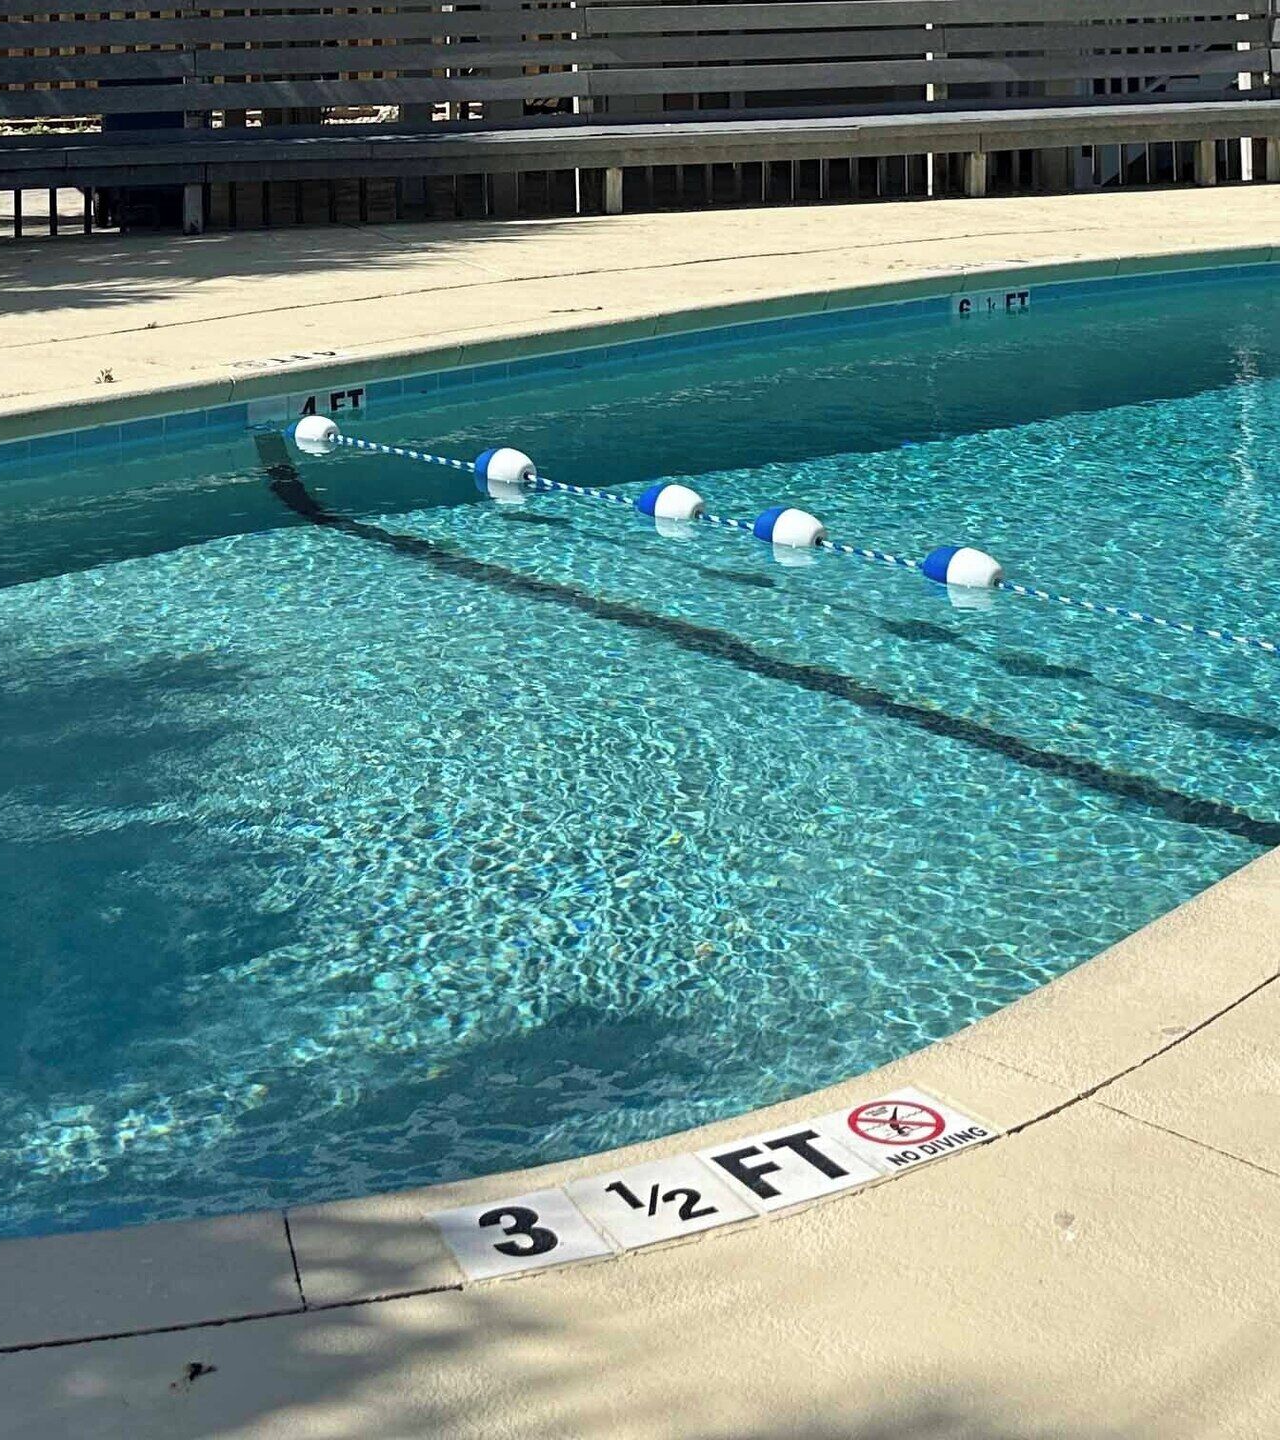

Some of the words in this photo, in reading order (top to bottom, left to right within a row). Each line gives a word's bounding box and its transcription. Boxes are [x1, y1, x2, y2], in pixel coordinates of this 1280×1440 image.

[1006, 291, 1029, 308] FT
[299, 396, 316, 415] 4
[330, 388, 363, 411] FT
[886, 1150, 918, 1166] NO
[924, 1126, 988, 1155] DIVING
[478, 1206, 558, 1257] 3
[710, 1129, 850, 1199] FT
